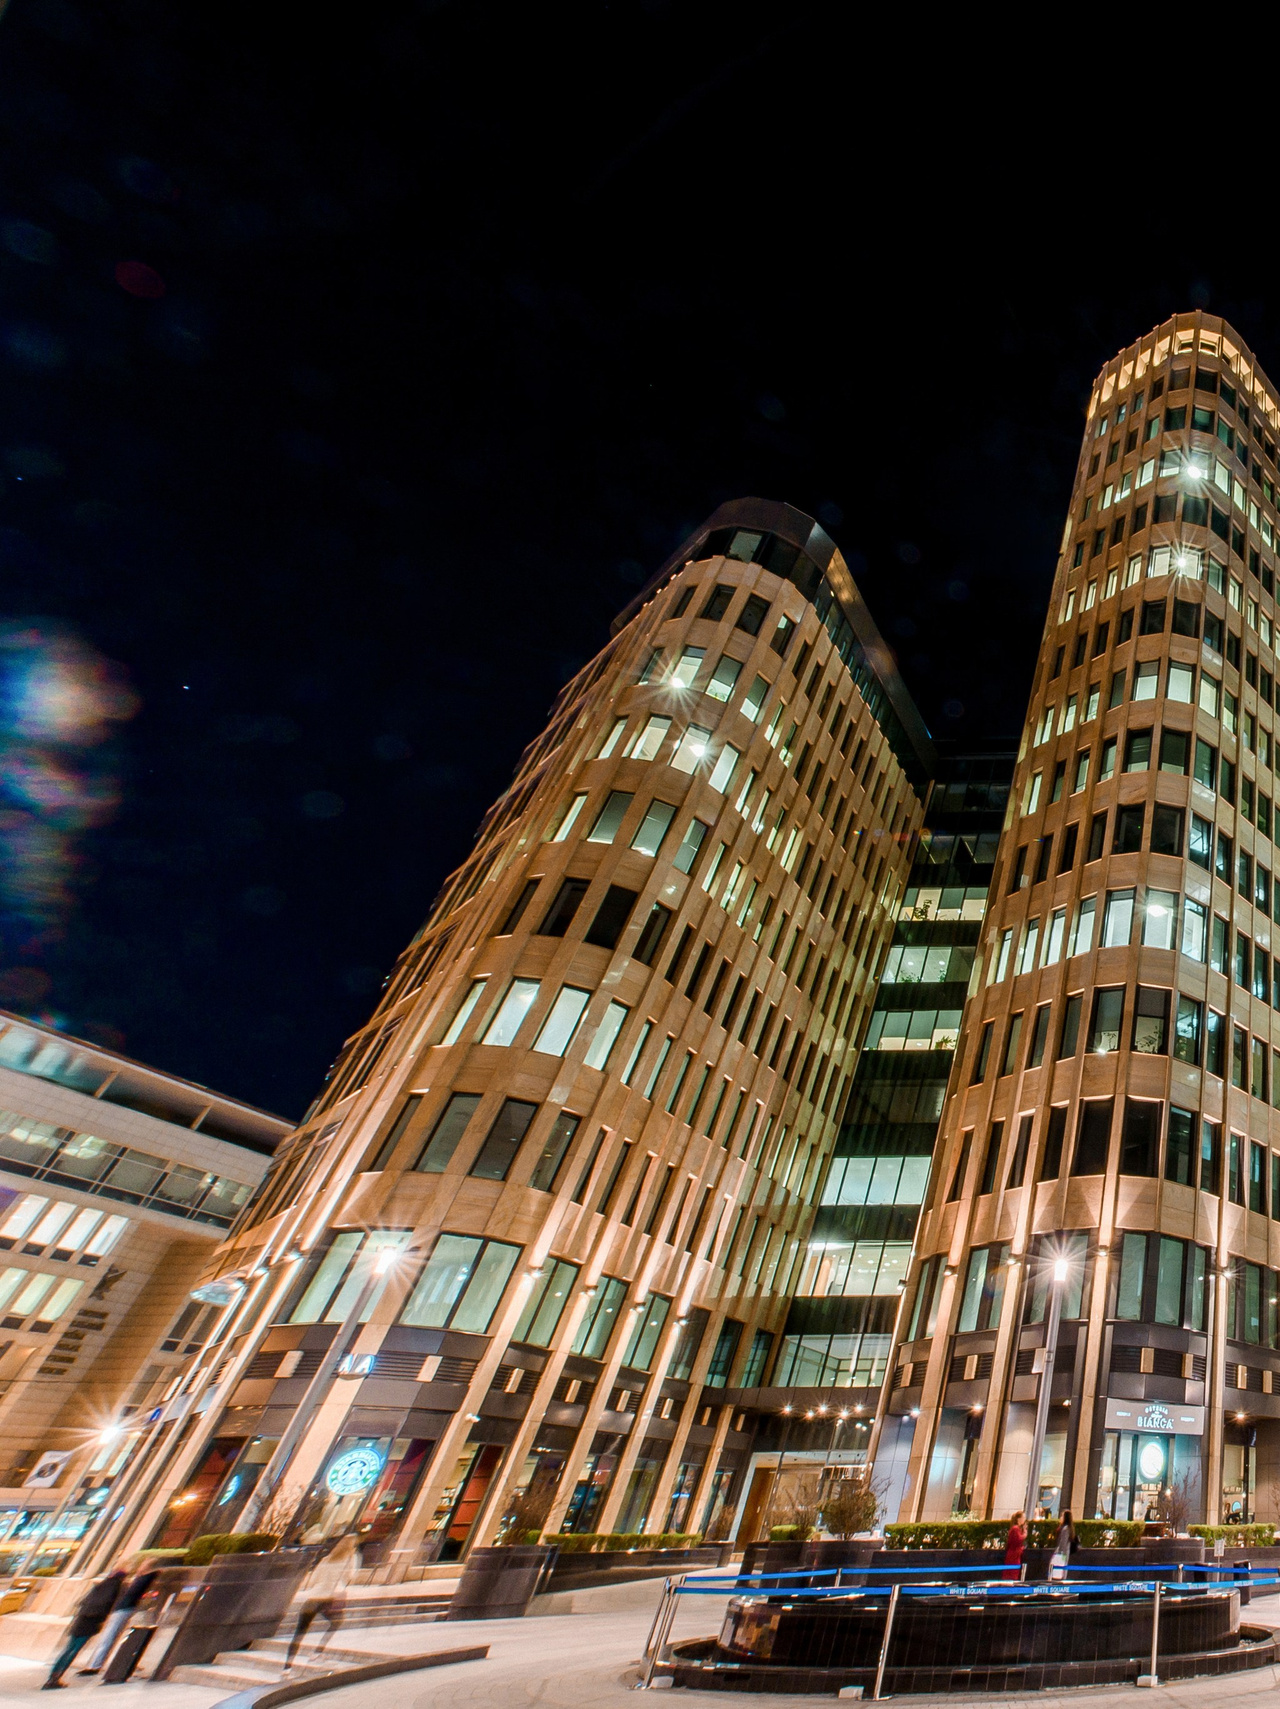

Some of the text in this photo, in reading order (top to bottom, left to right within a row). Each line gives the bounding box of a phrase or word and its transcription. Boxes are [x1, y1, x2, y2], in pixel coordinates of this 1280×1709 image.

[1137, 1416, 1174, 1429] BIANCA
[967, 1587, 988, 1595] SQUARE
[1113, 1583, 1149, 1592] WHITE SQUARE
